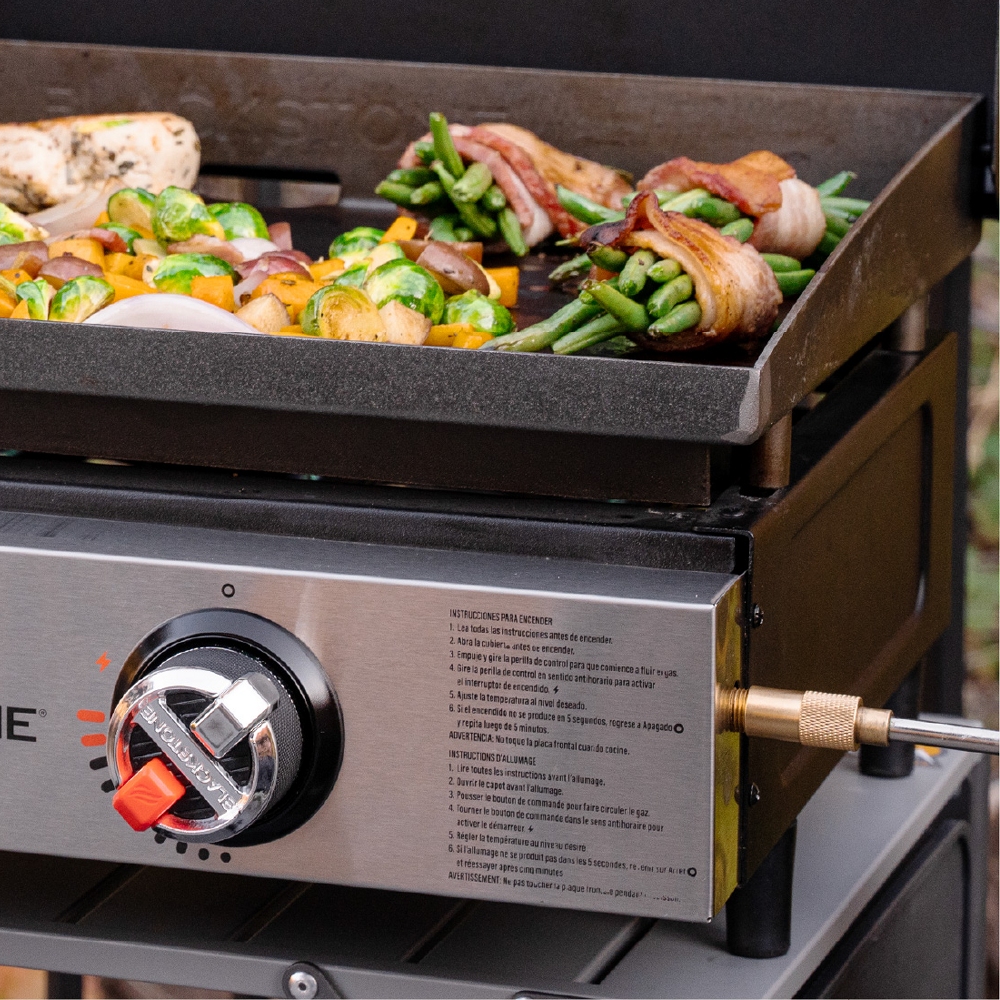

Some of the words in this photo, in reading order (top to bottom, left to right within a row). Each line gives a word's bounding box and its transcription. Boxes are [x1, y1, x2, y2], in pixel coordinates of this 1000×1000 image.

[449, 609, 500, 622] INSTRUCCIONES
[500, 613, 518, 623] PARA
[519, 614, 553, 626] ENCENDER
[457, 623, 469, 633] Lea
[470, 624, 489, 634] todas
[490, 626, 501, 635] las
[501, 627, 549, 639] instrucciones
[548, 632, 569, 641] antes
[569, 632, 578, 642] de
[579, 635, 613, 644] encender.
[449, 636, 456, 645] 2.
[457, 637, 473, 647] Abra
[474, 638, 481, 648] la
[541, 645, 575, 655] encender.
[457, 650, 482, 662] Empuje
[482, 654, 487, 663] y
[488, 653, 502, 664] gire
[503, 653, 510, 663] la
[510, 656, 533, 666] perilla
[533, 656, 543, 666] de
[543, 659, 569, 668] control
[569, 661, 585, 671] para
[586, 662, 600, 672] que
[600, 663, 634, 674] comience
[634, 666, 640, 675] a
[640, 665, 656, 676] fluir
[449, 663, 455, 671] 4.
[457, 663, 471, 673] Gire
[472, 665, 478, 674] la
[479, 666, 502, 676] perilla
[502, 667, 511, 677] de
[511, 670, 537, 679] control
[537, 671, 547, 680] en
[547, 672, 574, 682] sentido
[614, 678, 630, 687] para
[631, 679, 656, 690] activar
[464, 678, 502, 690] interruptor
[503, 681, 512, 691] de
[449, 689, 456, 699] 5.
[457, 690, 478, 701] Ajuste
[479, 692, 486, 702] la
[486, 693, 530, 706] temperatura
[530, 697, 537, 706] al
[538, 699, 555, 708] nivel
[556, 699, 587, 710] deseado.
[449, 703, 455, 713] 6.
[464, 705, 471, 714] el
[471, 707, 507, 717] encendido
[508, 710, 517, 718] no
[518, 711, 526, 719] se
[527, 711, 556, 722] produce
[557, 714, 566, 723] en
[566, 713, 572, 723] 5
[609, 719, 636, 729] regrese
[642, 721, 674, 733] Apagado
[457, 719, 461, 728] y
[462, 718, 483, 729] repita
[483, 720, 503, 732] luego
[503, 722, 513, 731] de
[513, 722, 518, 732] 5
[519, 723, 549, 734] minutos.
[495, 735, 505, 744] No
[505, 736, 526, 747] toque
[526, 737, 533, 747] la
[534, 738, 553, 748] placa
[553, 740, 578, 751] frontal
[605, 745, 630, 755] cocine.
[140, 705, 237, 811] BLACKSTONE
[448, 749, 495, 762] INSTRUCTIONS
[495, 753, 536, 766] D'ALLUMAGE
[448, 763, 454, 772] 1.
[457, 764, 470, 773] Lire
[470, 765, 493, 776] toutes
[493, 766, 504, 777] les
[504, 769, 547, 781] instructions
[547, 773, 567, 782] avant
[478, 779, 485, 788] le
[485, 781, 506, 791] capot
[506, 783, 525, 792] avant
[457, 790, 484, 801] Pousser
[492, 794, 517, 805] bouton
[517, 796, 526, 806] de
[527, 798, 565, 810] commande
[566, 802, 582, 811] pour
[583, 802, 600, 813] faire
[600, 805, 628, 815] circuler
[628, 807, 635, 816] le
[456, 819, 480, 828] activer
[481, 820, 487, 829] le
[483, 806, 490, 816] le
[491, 808, 515, 818] bouton
[516, 810, 525, 819] de
[564, 814, 582, 825] dans
[582, 815, 589, 825] le
[590, 818, 607, 827] sens
[647, 823, 664, 832] pour
[479, 833, 486, 842] la
[486, 834, 530, 847] température
[529, 839, 539, 848] au
[456, 844, 463, 854] Si
[499, 850, 509, 859] ne
[510, 851, 518, 859] se
[518, 852, 544, 862] produit
[544, 855, 558, 864] pas
[576, 857, 587, 866] les
[456, 859, 464, 868] et
[513, 879, 525, 888] pas
